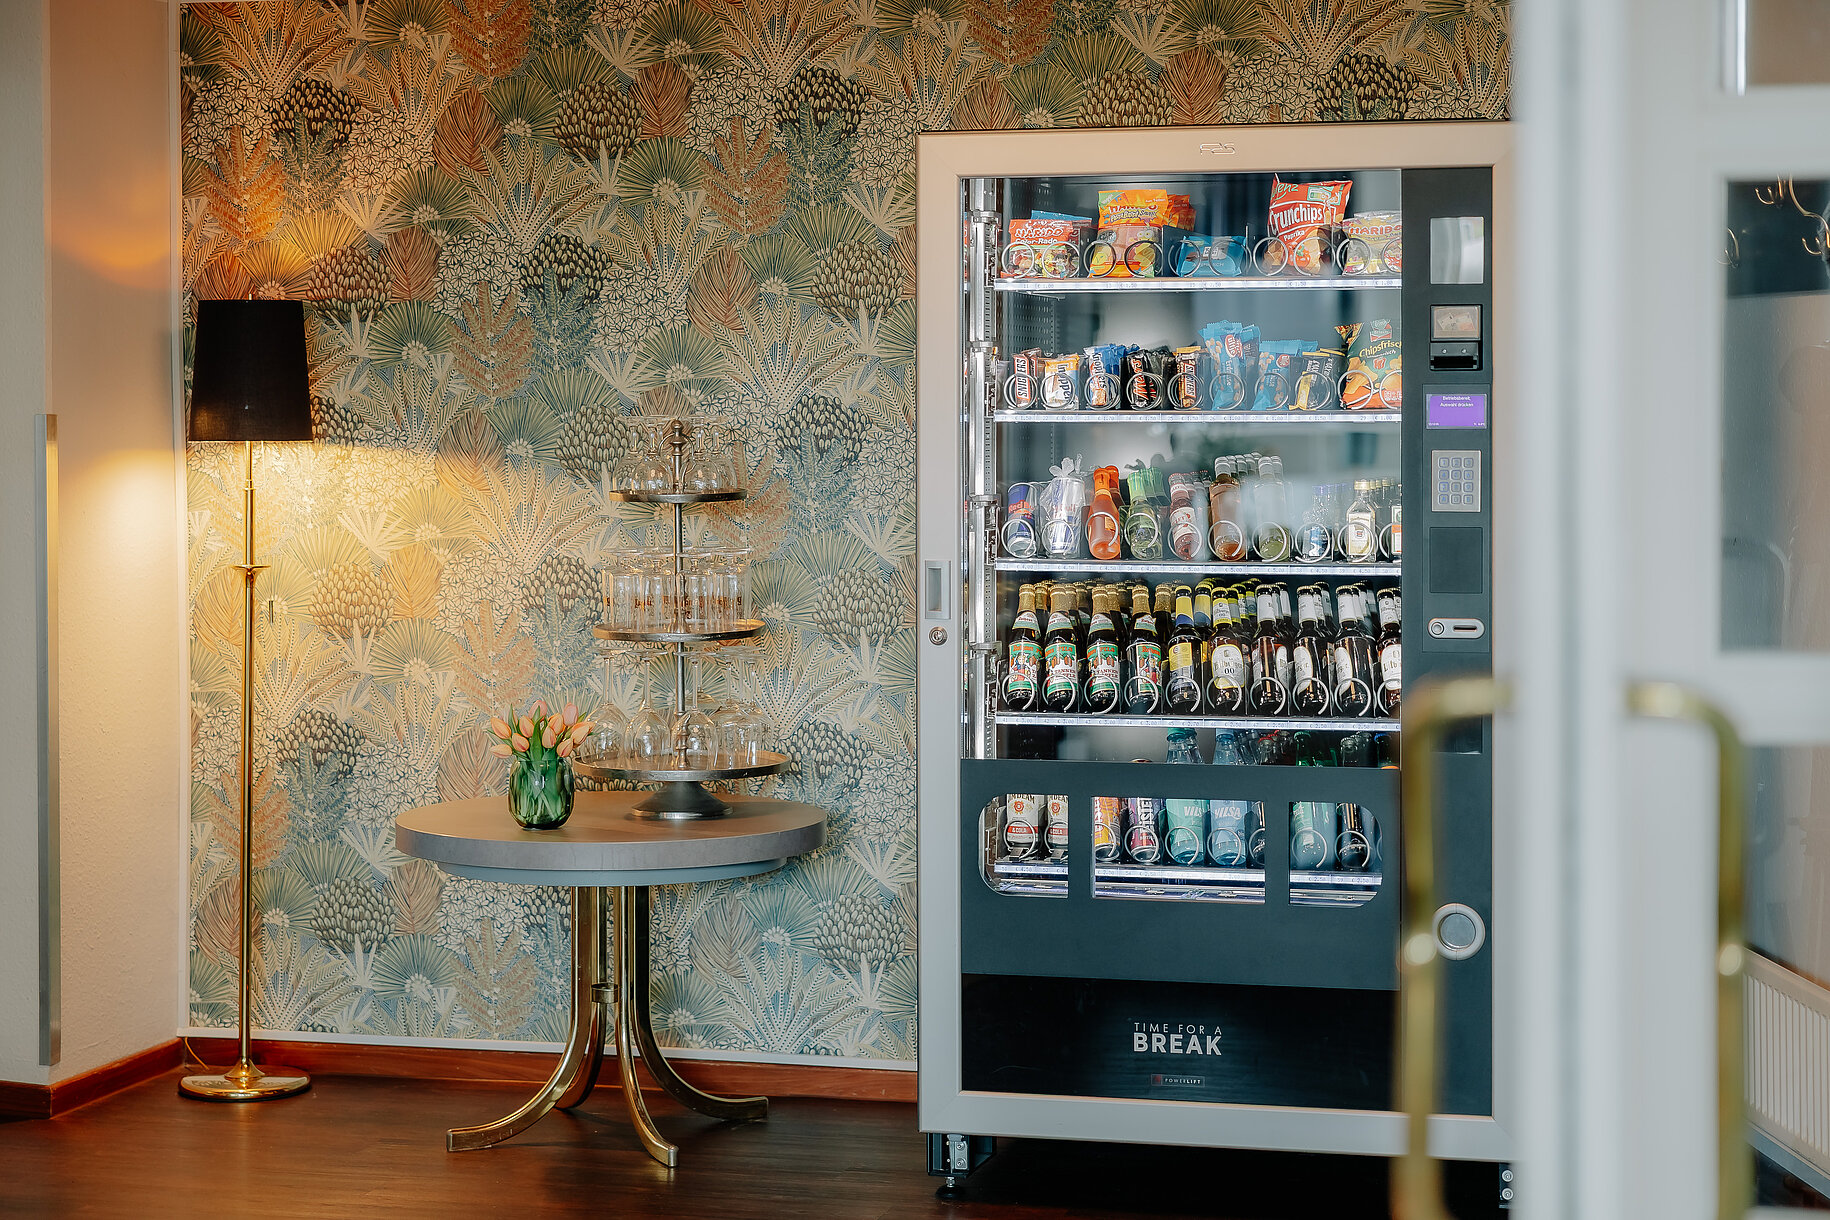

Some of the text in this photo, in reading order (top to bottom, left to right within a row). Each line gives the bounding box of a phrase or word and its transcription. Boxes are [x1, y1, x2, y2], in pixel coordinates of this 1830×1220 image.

[1014, 227, 1065, 238] HARIBO
[1016, 358, 1027, 397] SNICERS
[1184, 364, 1195, 395] SNCKERS
[1008, 500, 1023, 514] Red
[1214, 806, 1242, 820] VILSA
[1134, 1022, 1222, 1035] TIME FOR A
[1133, 1032, 1222, 1056] BREAK
